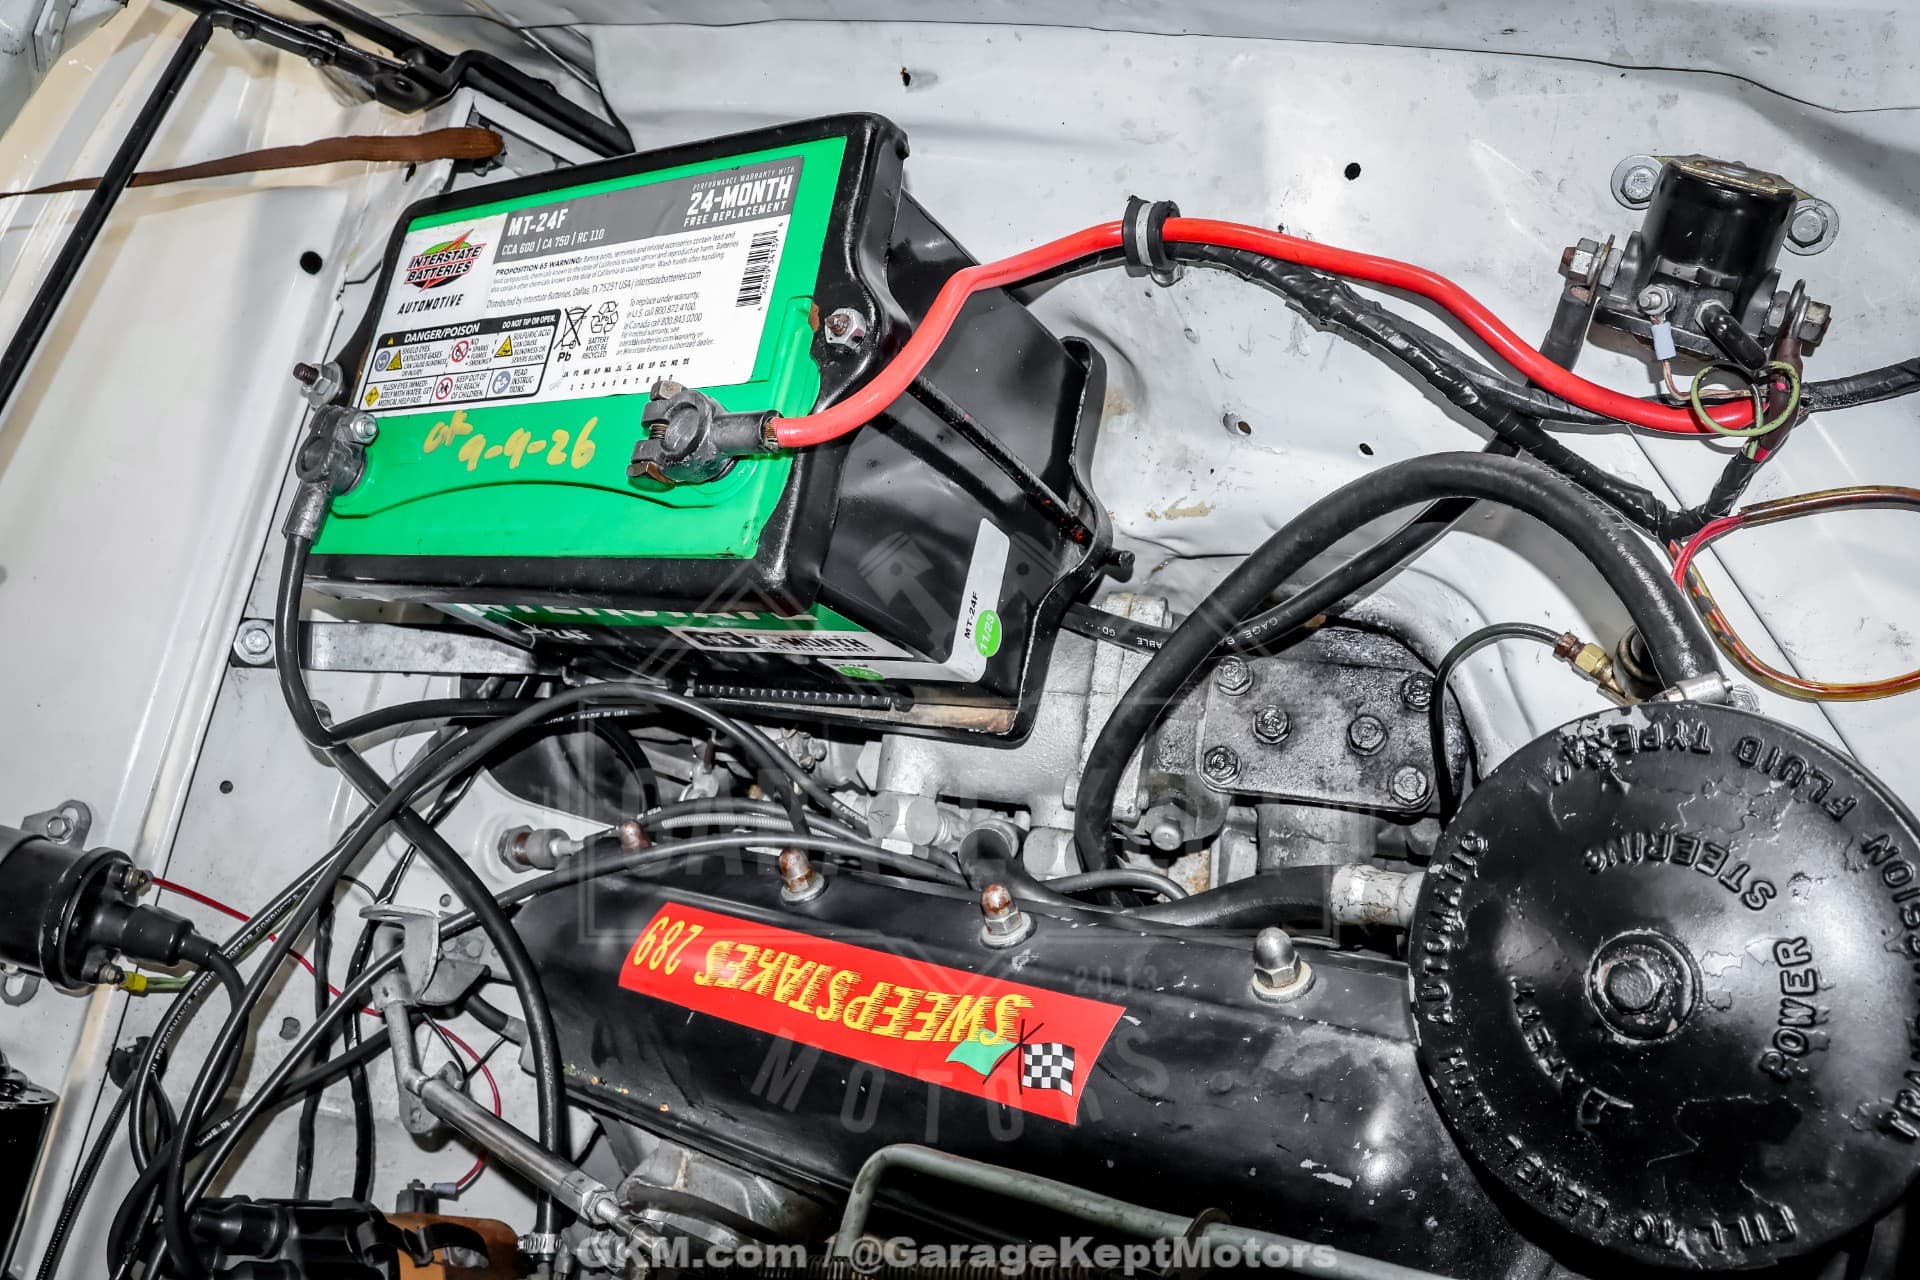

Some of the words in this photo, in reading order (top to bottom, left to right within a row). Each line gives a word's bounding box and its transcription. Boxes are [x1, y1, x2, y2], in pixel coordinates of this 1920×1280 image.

[692, 176, 737, 191] PERFORMANCE
[740, 169, 775, 182] WARRANTY
[778, 165, 795, 176] WITH
[687, 175, 793, 216] 24-MONTH
[507, 208, 569, 237] MT-24F
[684, 214, 708, 227] FREE
[712, 200, 788, 223] REPLACEMENT
[502, 243, 518, 256] CCA
[520, 241, 535, 254] 600
[542, 237, 552, 250] CA
[555, 235, 570, 248] 750
[578, 231, 589, 243] RC
[590, 228, 605, 241] 110
[408, 246, 482, 268] INTERSTATE
[496, 263, 538, 277] PROPOSITION
[550, 256, 582, 268] WARNING:
[408, 260, 472, 281] BATTERIES
[397, 294, 464, 314] AUTOMOTIVE
[404, 323, 480, 344] DANGER/POISON
[502, 320, 510, 329] DO
[511, 319, 523, 328] NOT
[532, 316, 540, 325] OR
[513, 330, 536, 340] SULFURIC
[538, 328, 551, 337] ACID
[471, 338, 480, 346] NO
[557, 350, 572, 362] Pb
[464, 381, 480, 390] REACH
[514, 368, 528, 377] READ
[964, 591, 979, 639] MT-24F
[1243, 616, 1279, 640] GAGE
[980, 614, 995, 650] 11/23
[1136, 636, 1163, 650] ABLE
[1608, 720, 1712, 755] TYPE
[1736, 735, 1858, 822] FLUID
[647, 806, 662, 816] USA
[1583, 831, 1777, 911] STEERING
[1418, 831, 1489, 1025] AUTOMATIC
[632, 915, 704, 976] 289
[154, 997, 194, 1060] PERFORMANCE
[254, 893, 299, 933] CONDUCTOR
[693, 939, 1036, 1046] SWEEPSTAKES
[1757, 935, 1820, 1084] POWER
